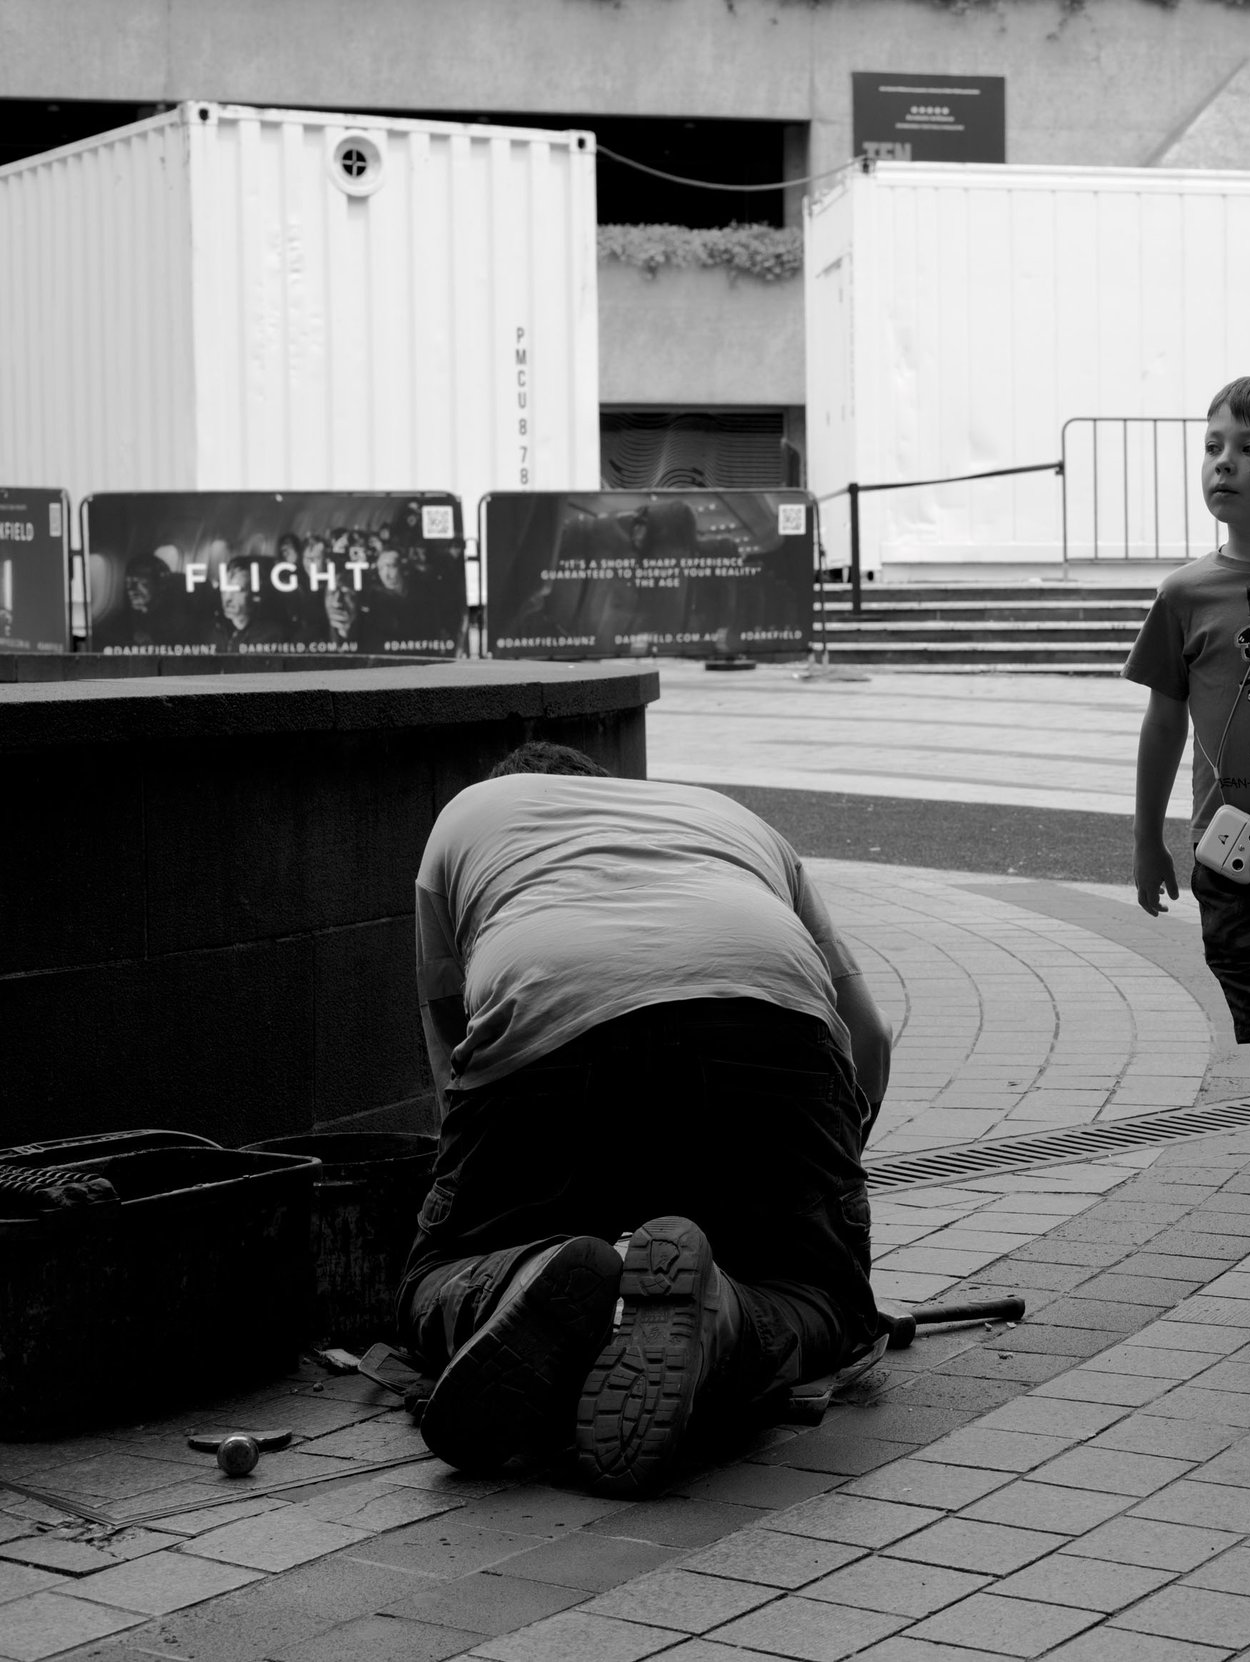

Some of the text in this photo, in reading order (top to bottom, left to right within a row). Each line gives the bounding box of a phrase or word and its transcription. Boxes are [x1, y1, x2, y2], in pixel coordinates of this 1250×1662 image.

[589, 559, 598, 569] A
[642, 558, 676, 568] SHARP
[680, 557, 744, 567] EXPERIENCE
[185, 561, 370, 593] FLIGHT
[540, 569, 614, 580] GUARANTEED
[617, 569, 633, 579] TO
[635, 568, 681, 579] DISRUPT
[683, 567, 712, 577] YOUR
[635, 578, 655, 588] THE
[658, 577, 680, 588] AGE
